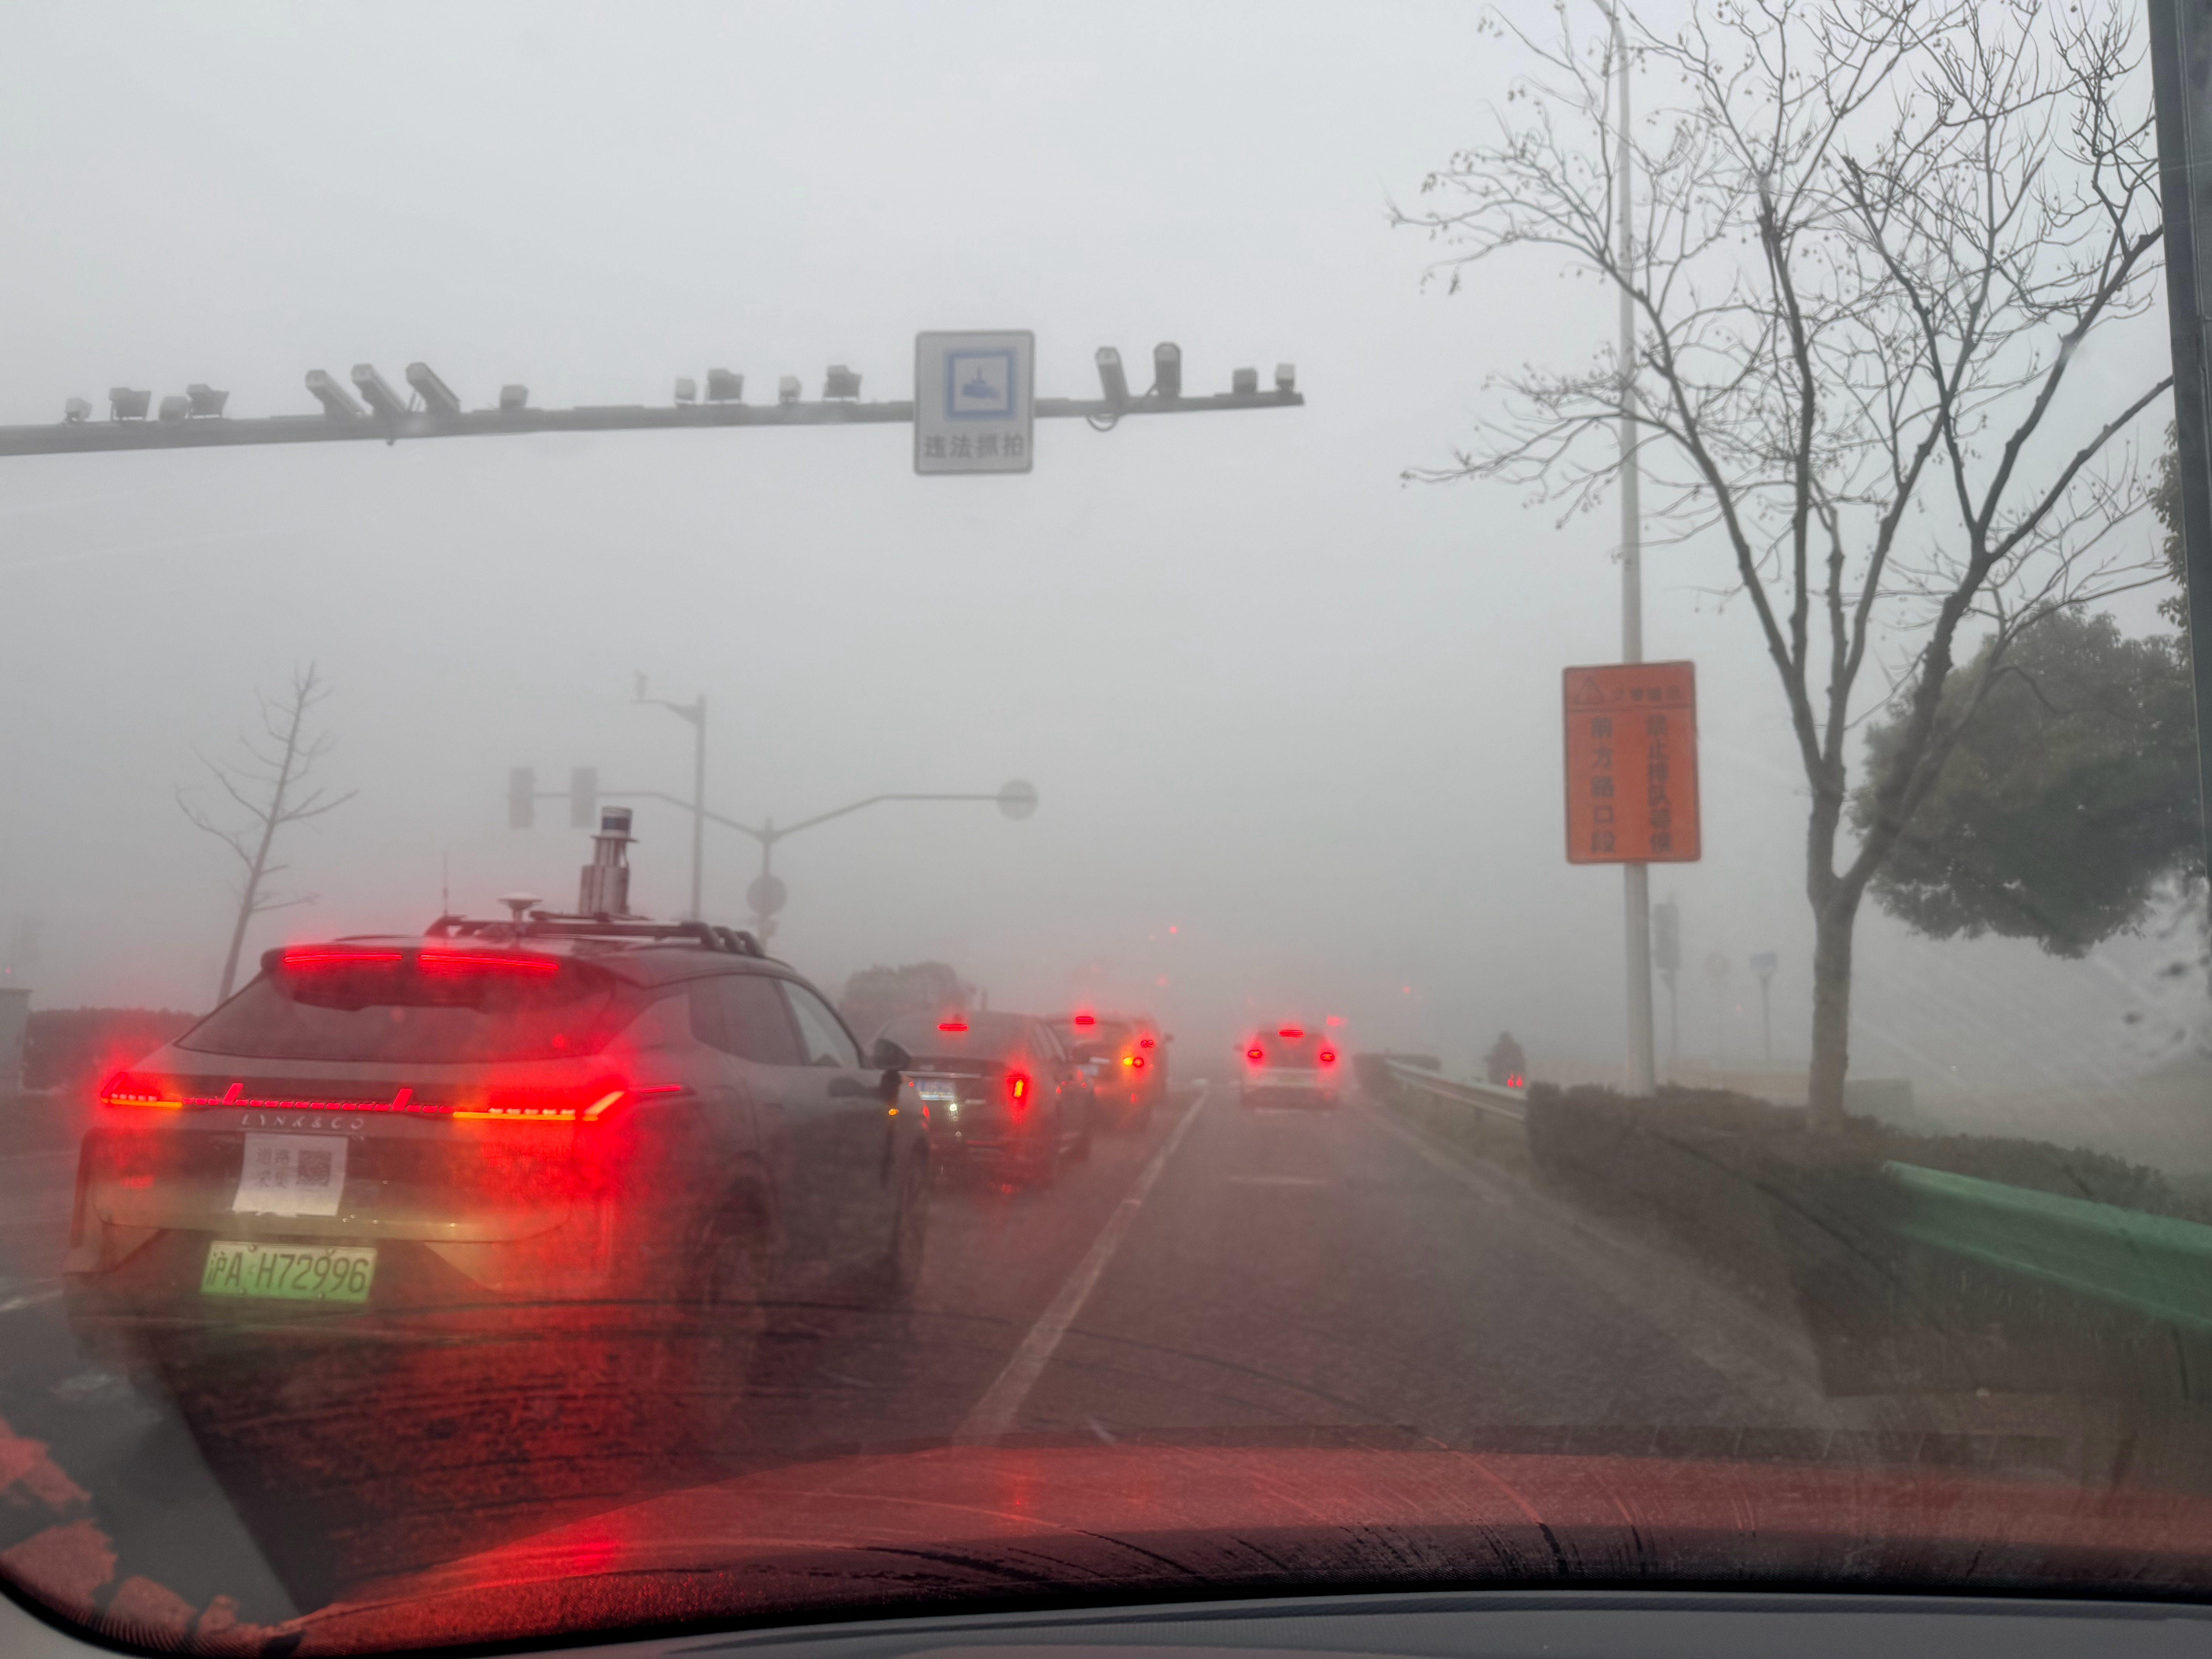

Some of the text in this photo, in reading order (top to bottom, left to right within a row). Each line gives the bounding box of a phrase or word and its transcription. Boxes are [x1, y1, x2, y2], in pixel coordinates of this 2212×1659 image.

[924, 433, 1025, 459] 违法抓拍
[1591, 717, 1616, 853] 前方路口段
[1646, 714, 1672, 853] 禁止排队等候
